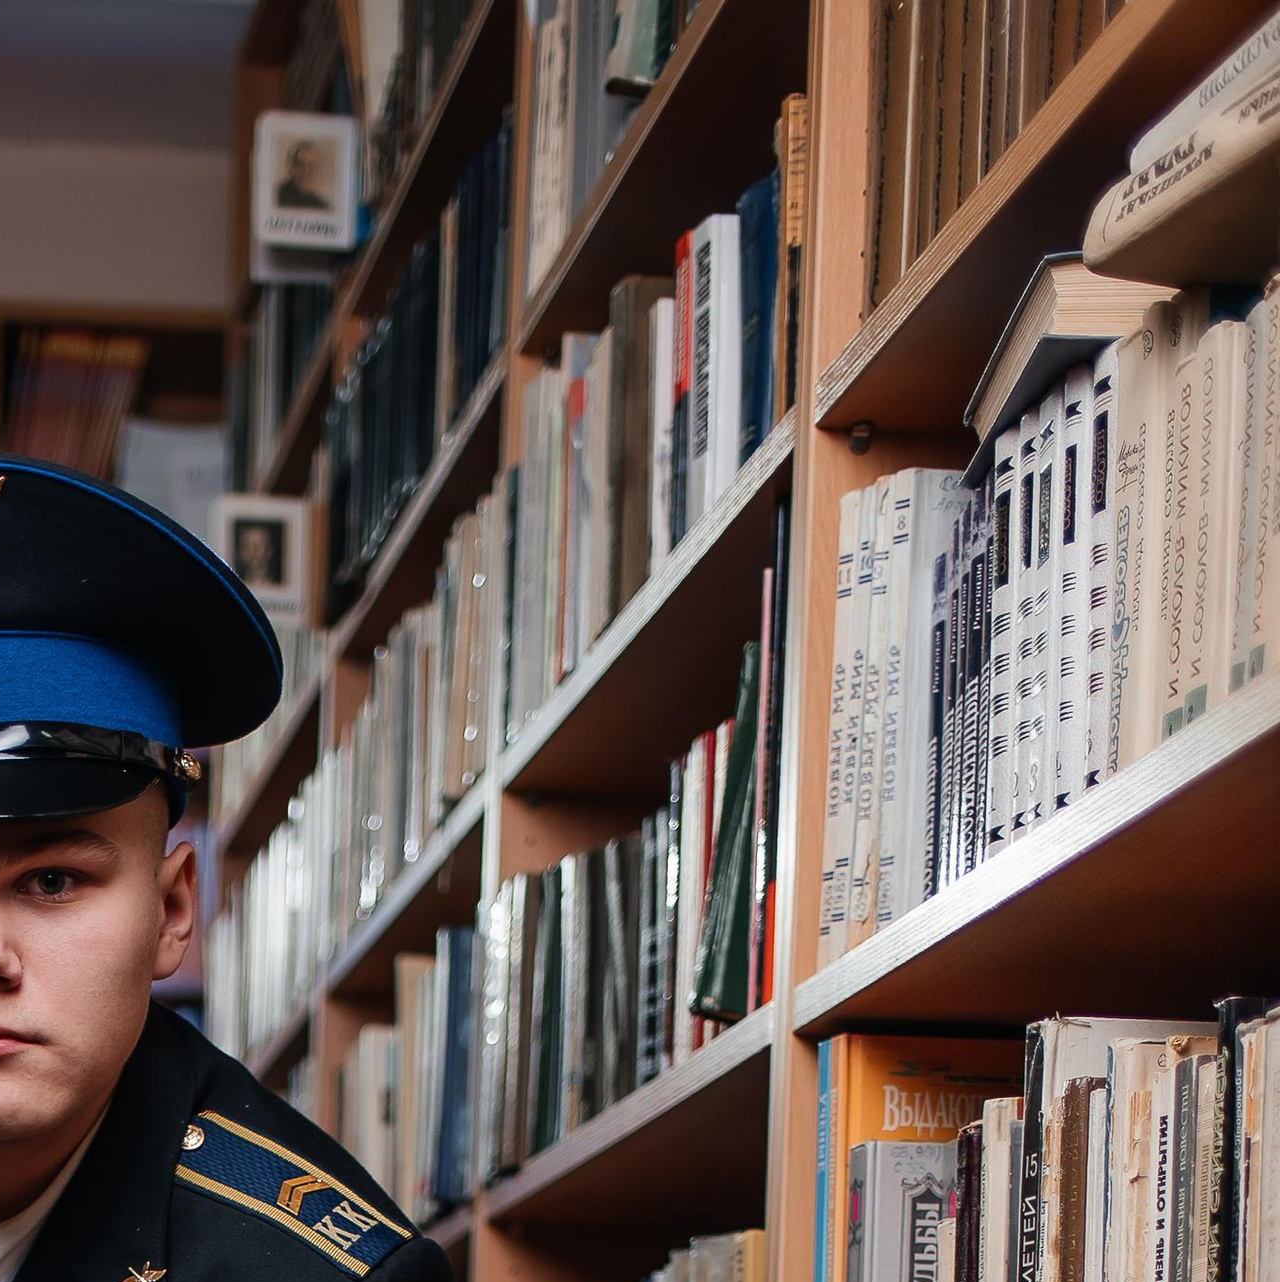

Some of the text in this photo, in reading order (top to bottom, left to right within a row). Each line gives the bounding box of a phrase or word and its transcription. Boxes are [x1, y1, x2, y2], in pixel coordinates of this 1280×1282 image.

[1160, 408, 1176, 620] ЛЕОНИД СОБОЛЕВ
[1169, 383, 1193, 665] СОКОЛОВ-МИКИТОВ
[1192, 357, 1215, 644] СОКОЛОВ-МИКИТОВ
[1109, 505, 1132, 654] СОБОЛЕВ
[1025, 1153, 1038, 1178] 15
[1154, 1114, 1169, 1213] ОТКРЫТИЯ
[1154, 1217, 1166, 1231] И
